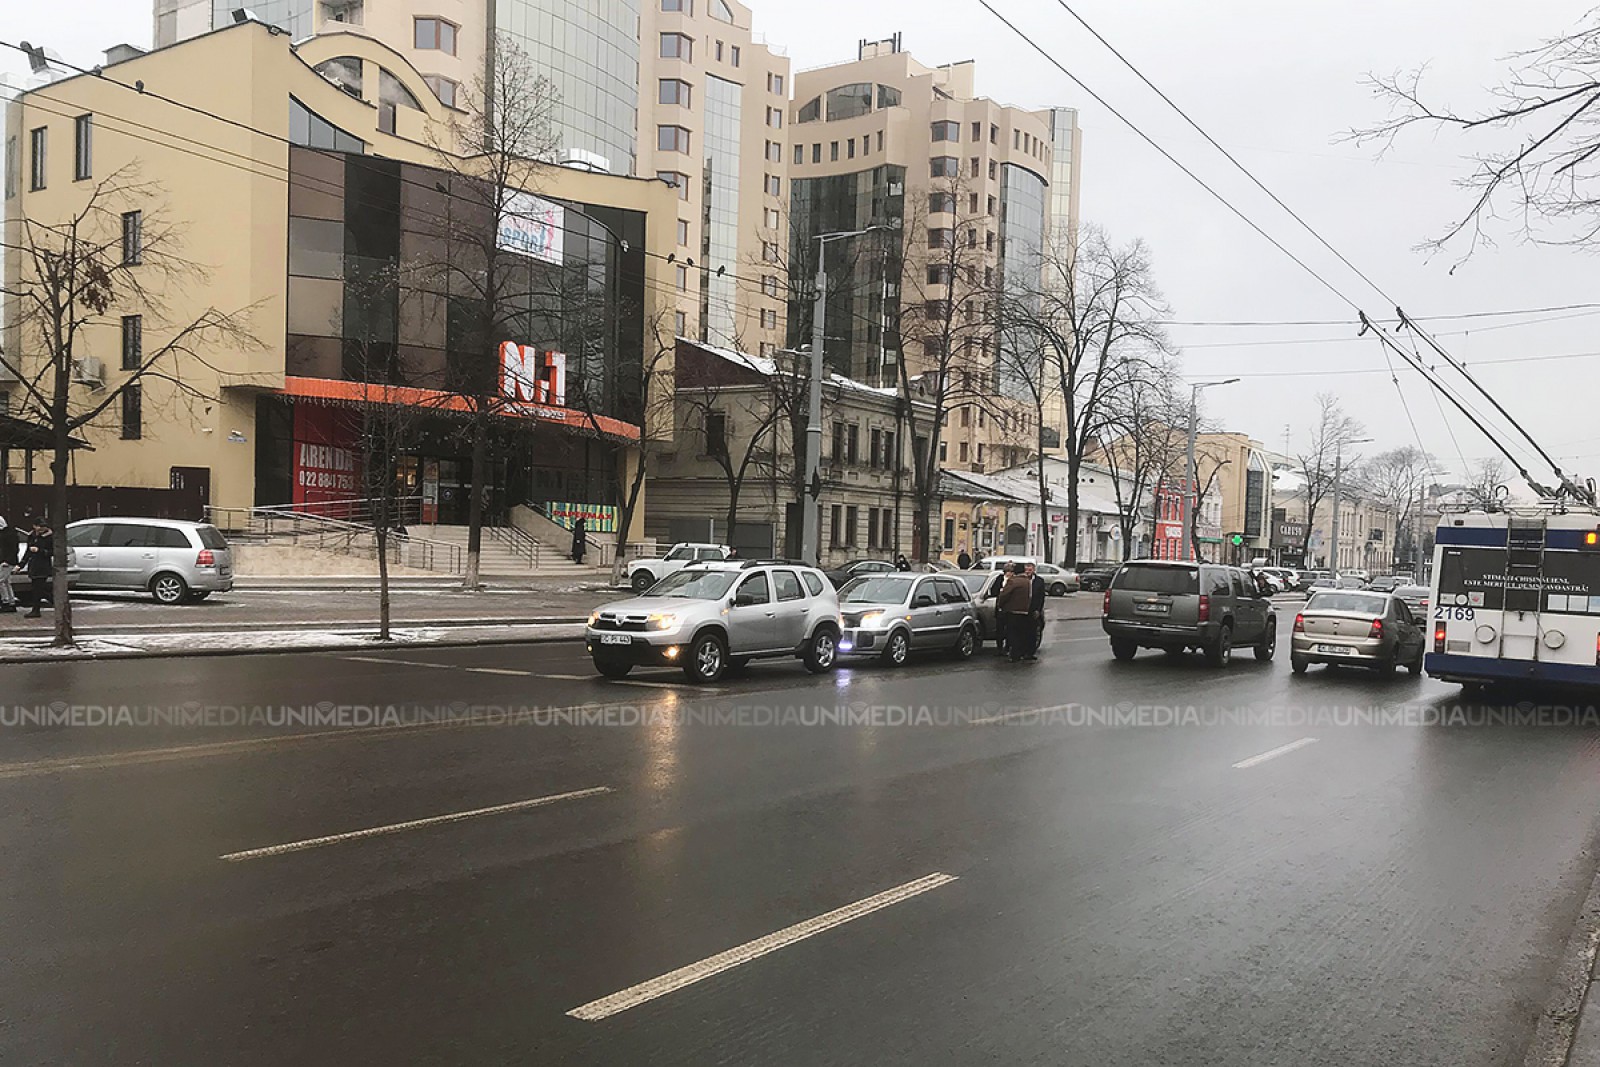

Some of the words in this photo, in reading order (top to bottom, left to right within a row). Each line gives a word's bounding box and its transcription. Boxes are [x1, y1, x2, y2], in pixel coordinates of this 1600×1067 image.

[299, 444, 354, 471] ARENDA
[552, 510, 612, 519] PAPERMAX
[1434, 607, 1474, 621] 2169
